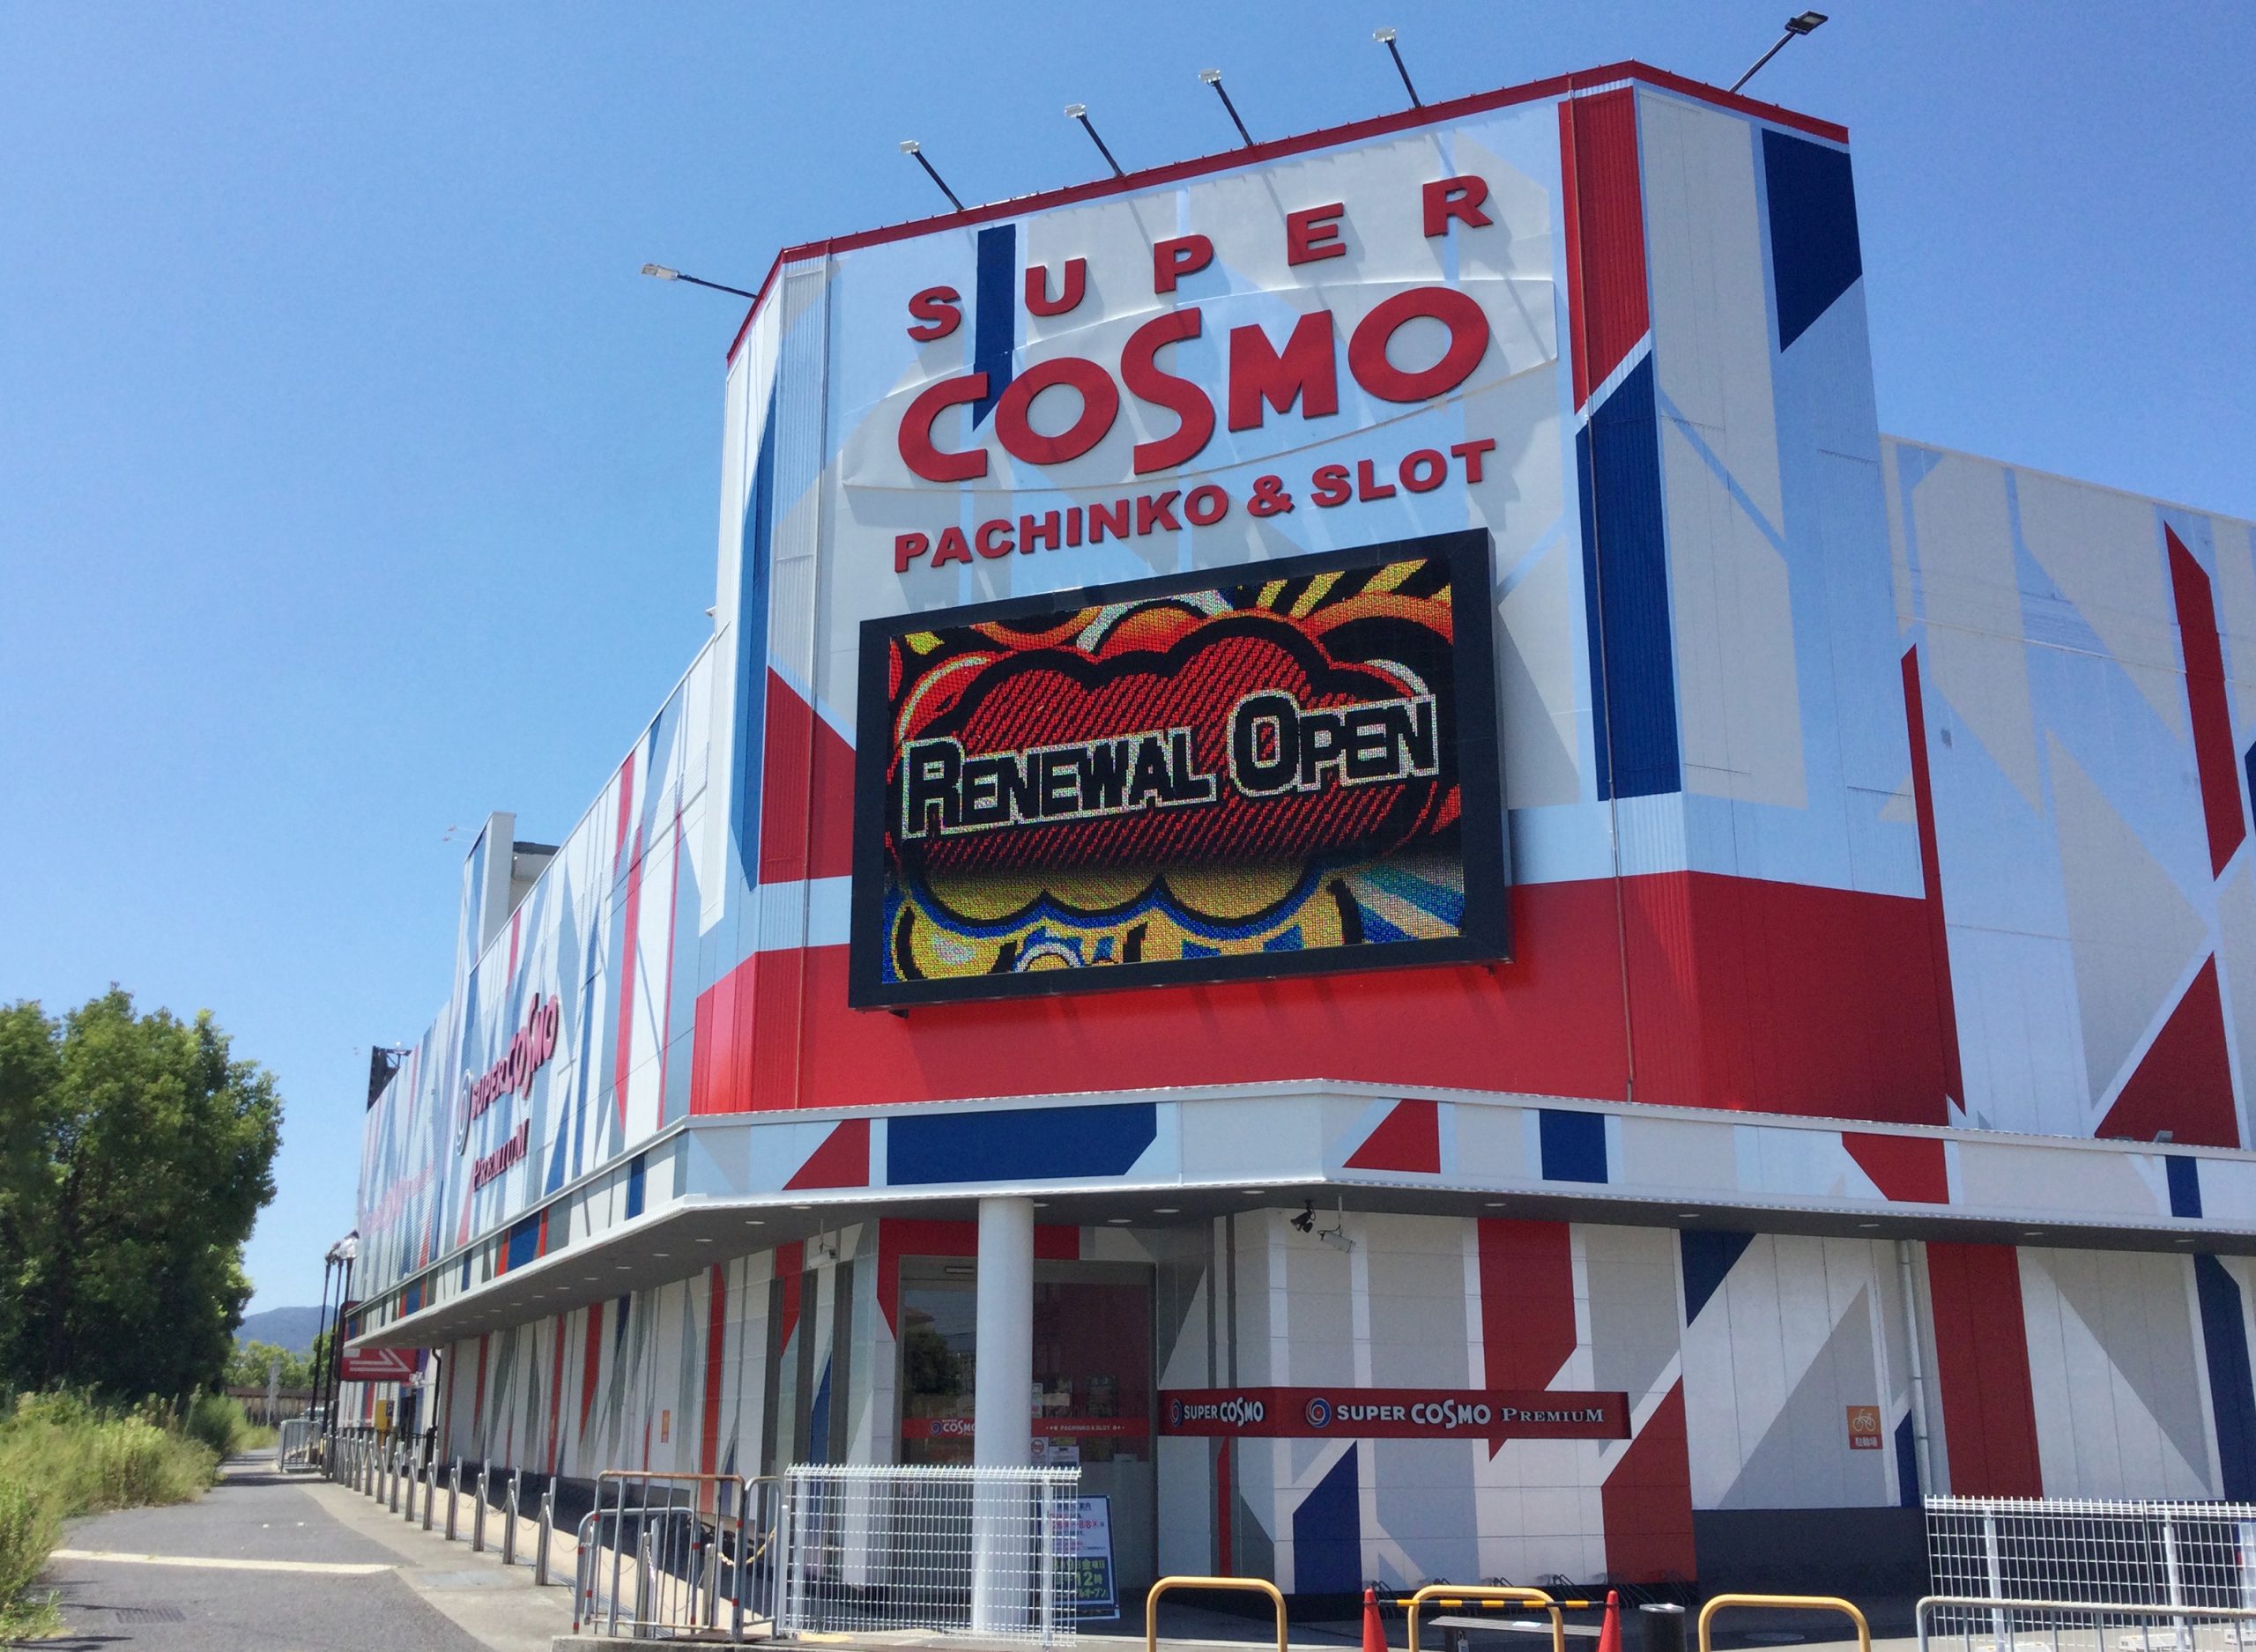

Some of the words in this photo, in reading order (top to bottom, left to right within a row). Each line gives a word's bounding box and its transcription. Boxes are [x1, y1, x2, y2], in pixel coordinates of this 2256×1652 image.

[907, 175, 1492, 341] SUPER
[898, 286, 1489, 482] COSMO
[894, 485, 1228, 573] PACHINKO
[1247, 474, 1294, 517] &
[1310, 438, 1495, 507] SLOT
[901, 727, 1217, 840] RENEWAL
[1226, 688, 1439, 797] OPEN
[470, 1057, 509, 1121] SUPER
[507, 992, 560, 1100] COSMO
[473, 1118, 530, 1191] PREMIUM
[1184, 1404, 1218, 1419] SUPER
[1220, 1396, 1264, 1427] COSMO
[1336, 1404, 1406, 1421] SUPER
[1410, 1398, 1491, 1429] COSMO
[1501, 1407, 1605, 1423] PREMIUM
